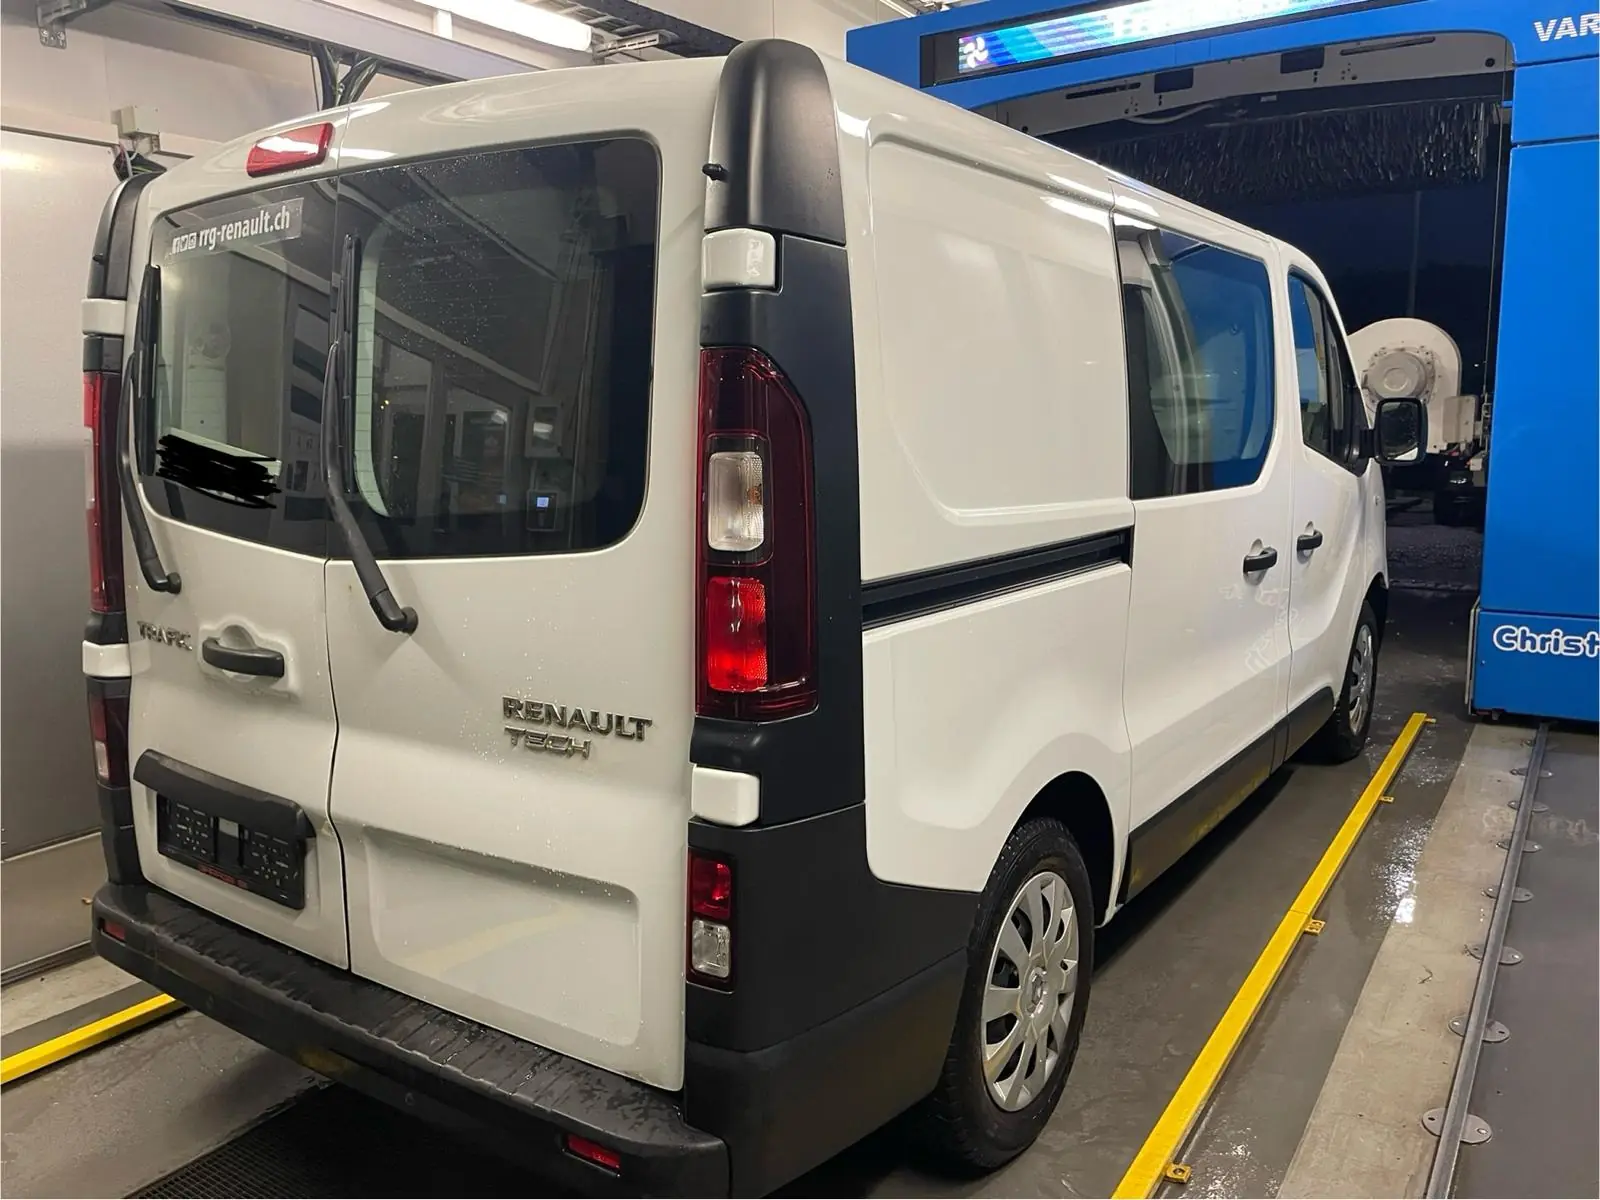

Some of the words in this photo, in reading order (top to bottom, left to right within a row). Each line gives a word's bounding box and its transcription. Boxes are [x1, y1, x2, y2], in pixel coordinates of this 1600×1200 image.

[1533, 12, 1599, 42] VAR
[198, 205, 291, 250] rrg-renault.ch
[1493, 625, 1599, 658] Christ
[502, 695, 653, 742] RENAULT
[504, 725, 592, 760] TECH
